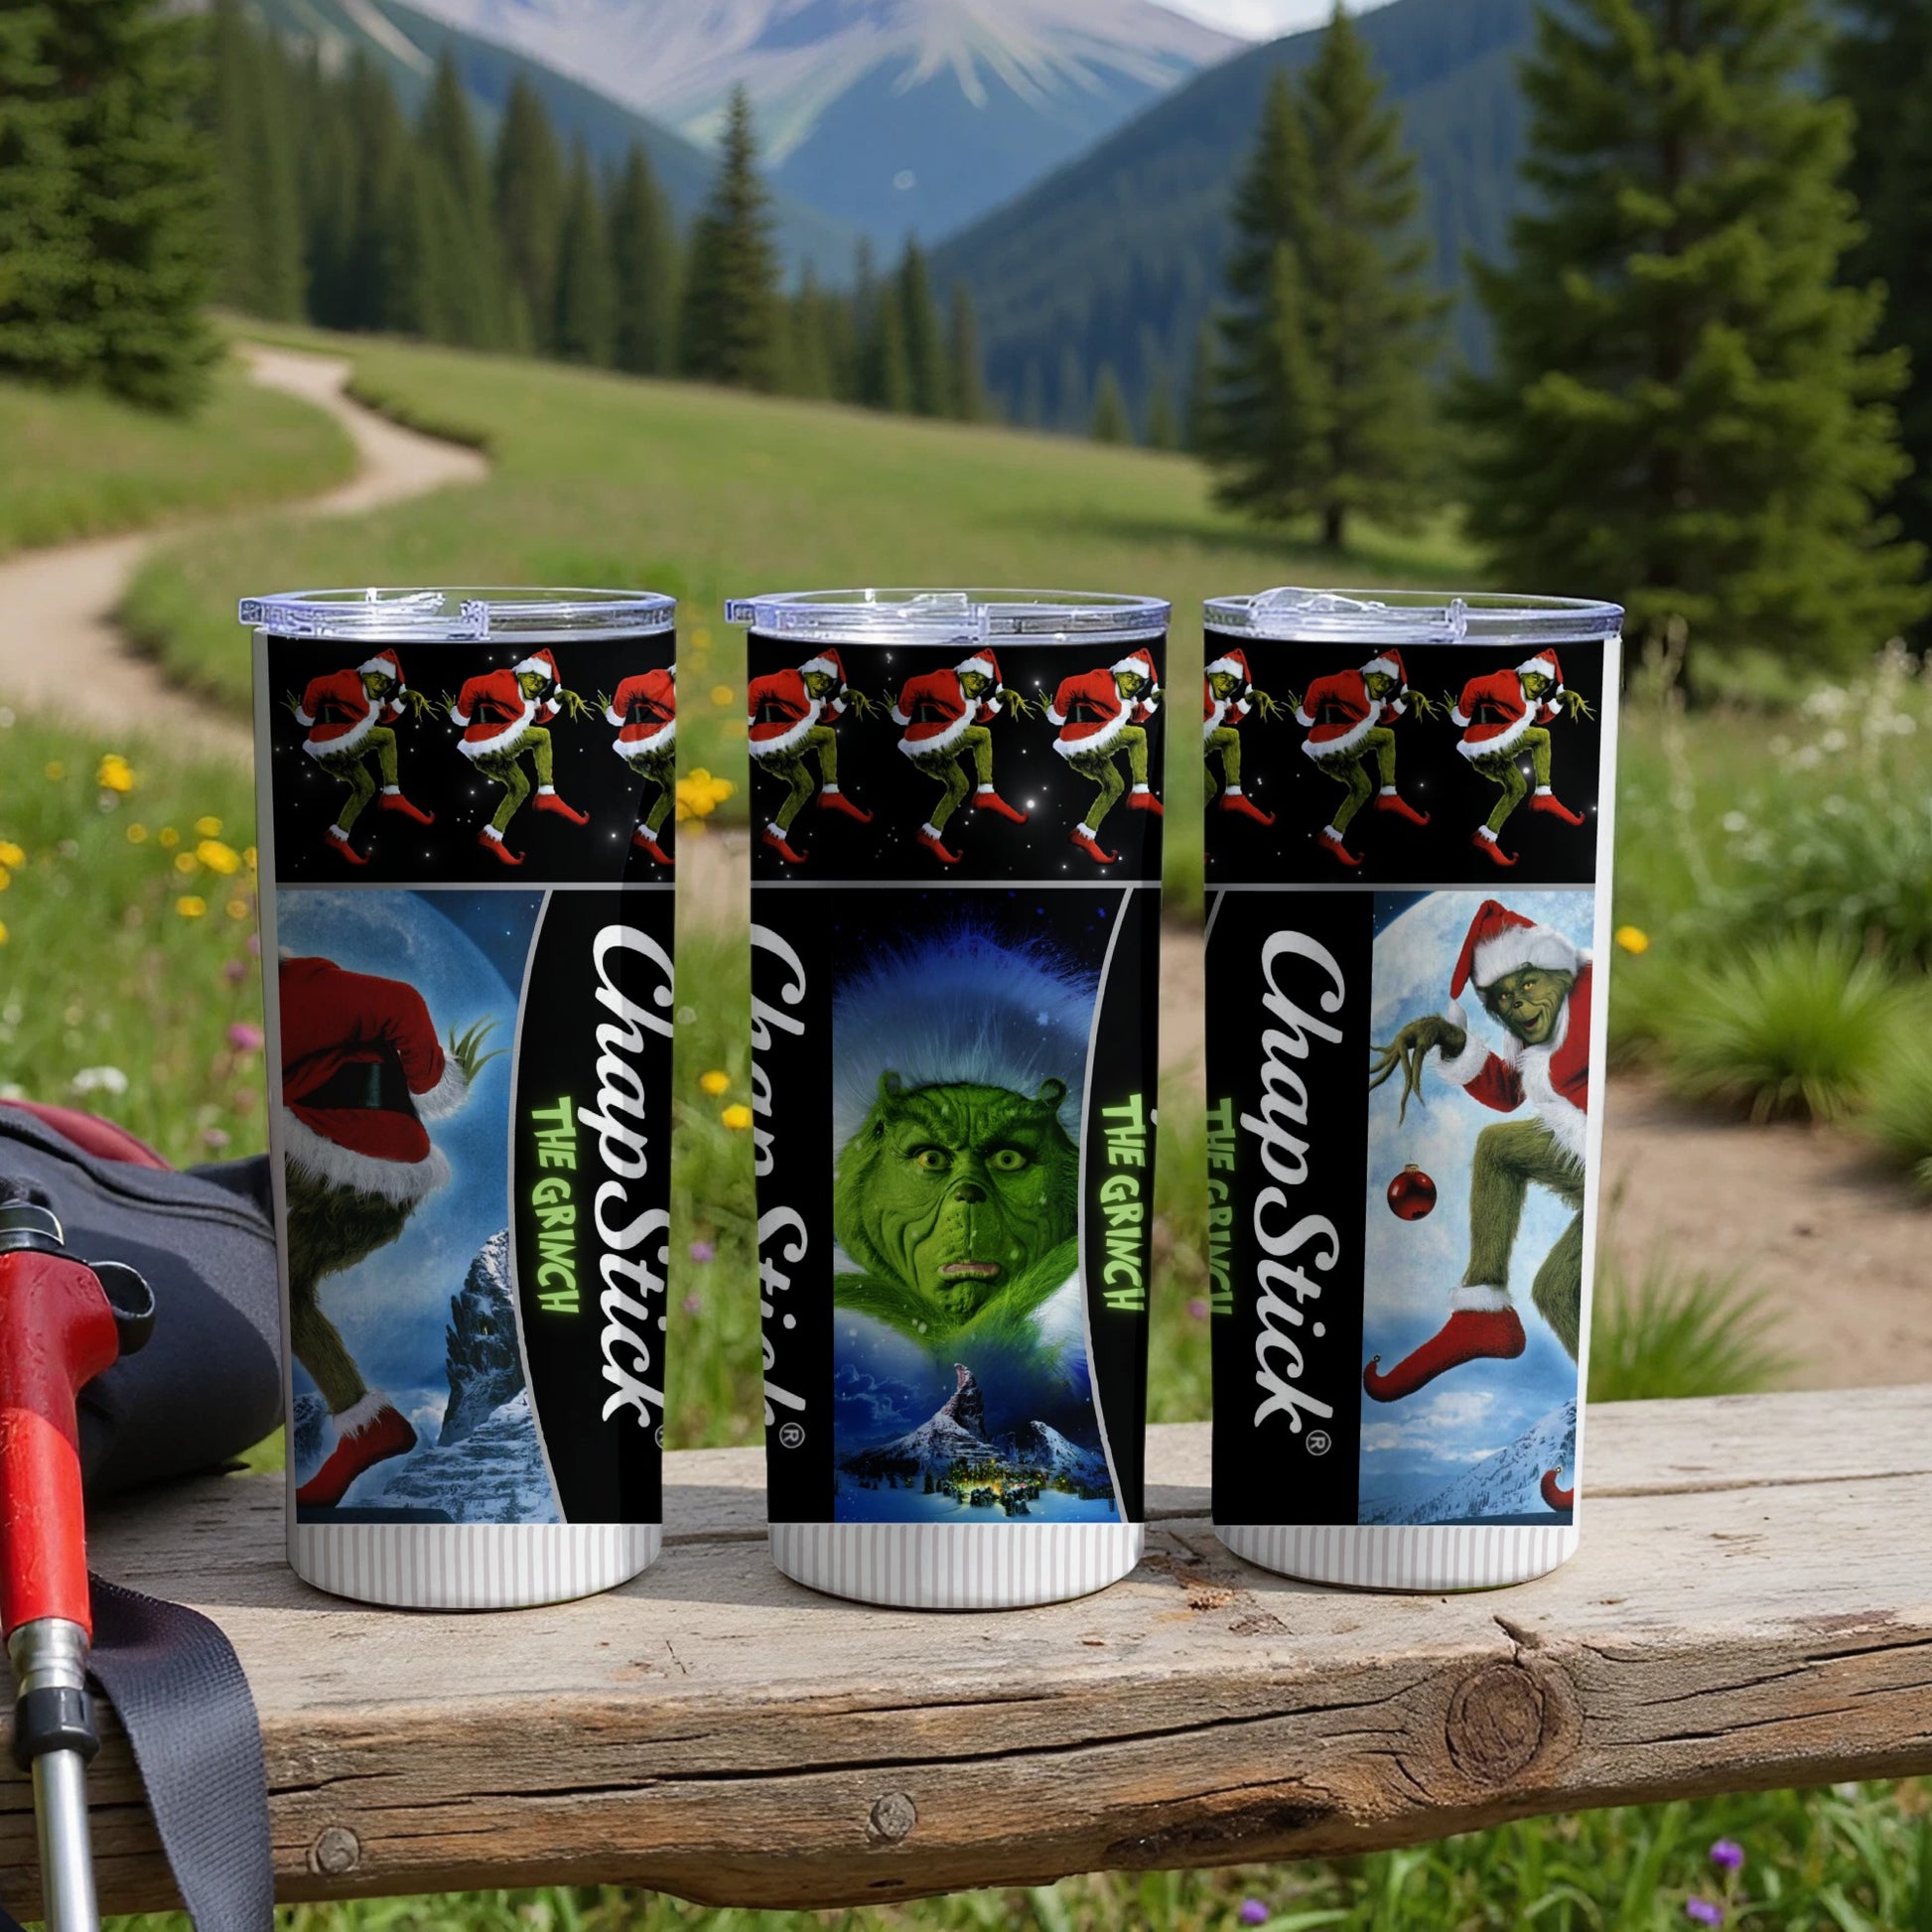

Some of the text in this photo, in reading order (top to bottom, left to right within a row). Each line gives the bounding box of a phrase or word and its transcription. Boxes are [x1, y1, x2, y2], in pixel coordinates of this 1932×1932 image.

[531, 1095, 580, 1314] THE GRINCH
[1100, 1093, 1147, 1311] THE GRINCH
[1206, 1097, 1236, 1172] THE
